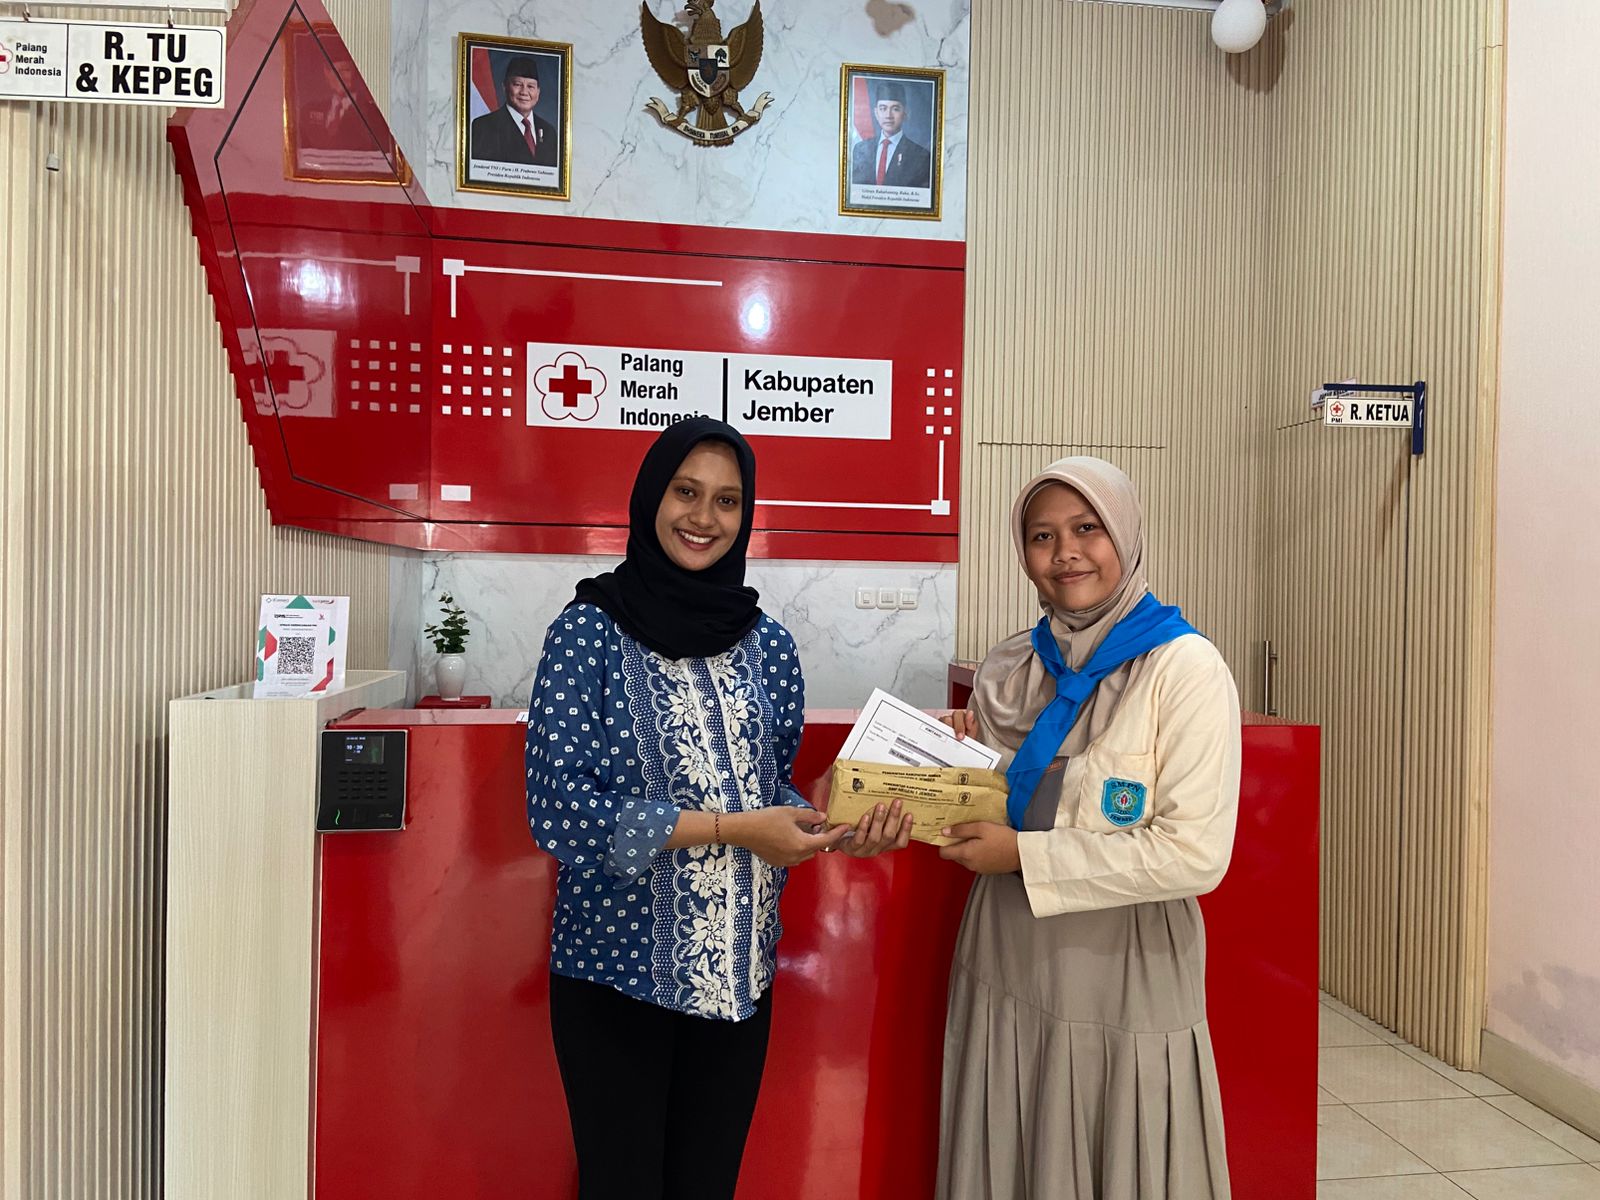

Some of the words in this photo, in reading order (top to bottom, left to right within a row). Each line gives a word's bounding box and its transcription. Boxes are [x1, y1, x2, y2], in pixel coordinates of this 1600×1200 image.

[15, 42, 47, 54] Palang
[104, 31, 135, 61] R.
[147, 32, 187, 63] TU
[15, 54, 45, 65] Merah
[15, 66, 62, 77] Indonesia
[75, 62, 99, 93] &
[112, 64, 213, 97] KEPEG
[620, 353, 684, 377] Palang
[620, 380, 679, 401] Merah
[743, 368, 875, 397] Kabupaten
[620, 407, 710, 426] Indone
[742, 400, 835, 424] Jember
[1350, 403, 1362, 421] R.
[1366, 403, 1409, 422] KETUA
